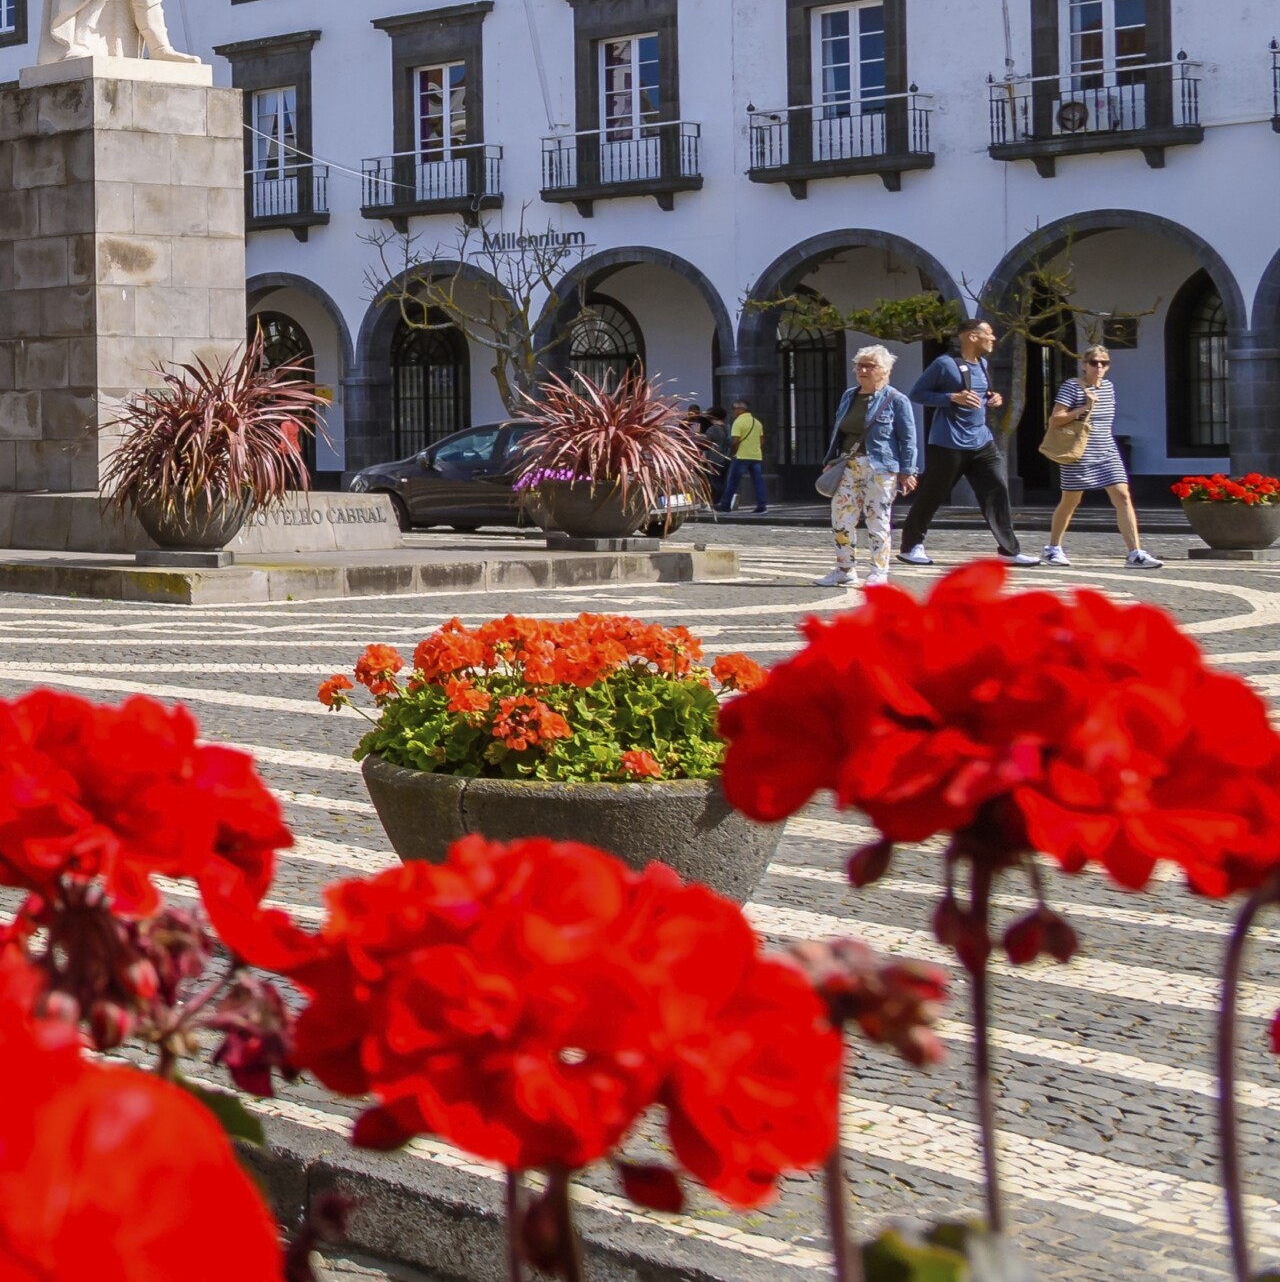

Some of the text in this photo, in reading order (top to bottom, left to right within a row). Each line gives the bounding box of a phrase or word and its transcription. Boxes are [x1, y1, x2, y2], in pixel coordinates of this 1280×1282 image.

[482, 230, 585, 251] Millennium
[270, 508, 322, 526] VELHO
[326, 507, 387, 524] CABRAL
